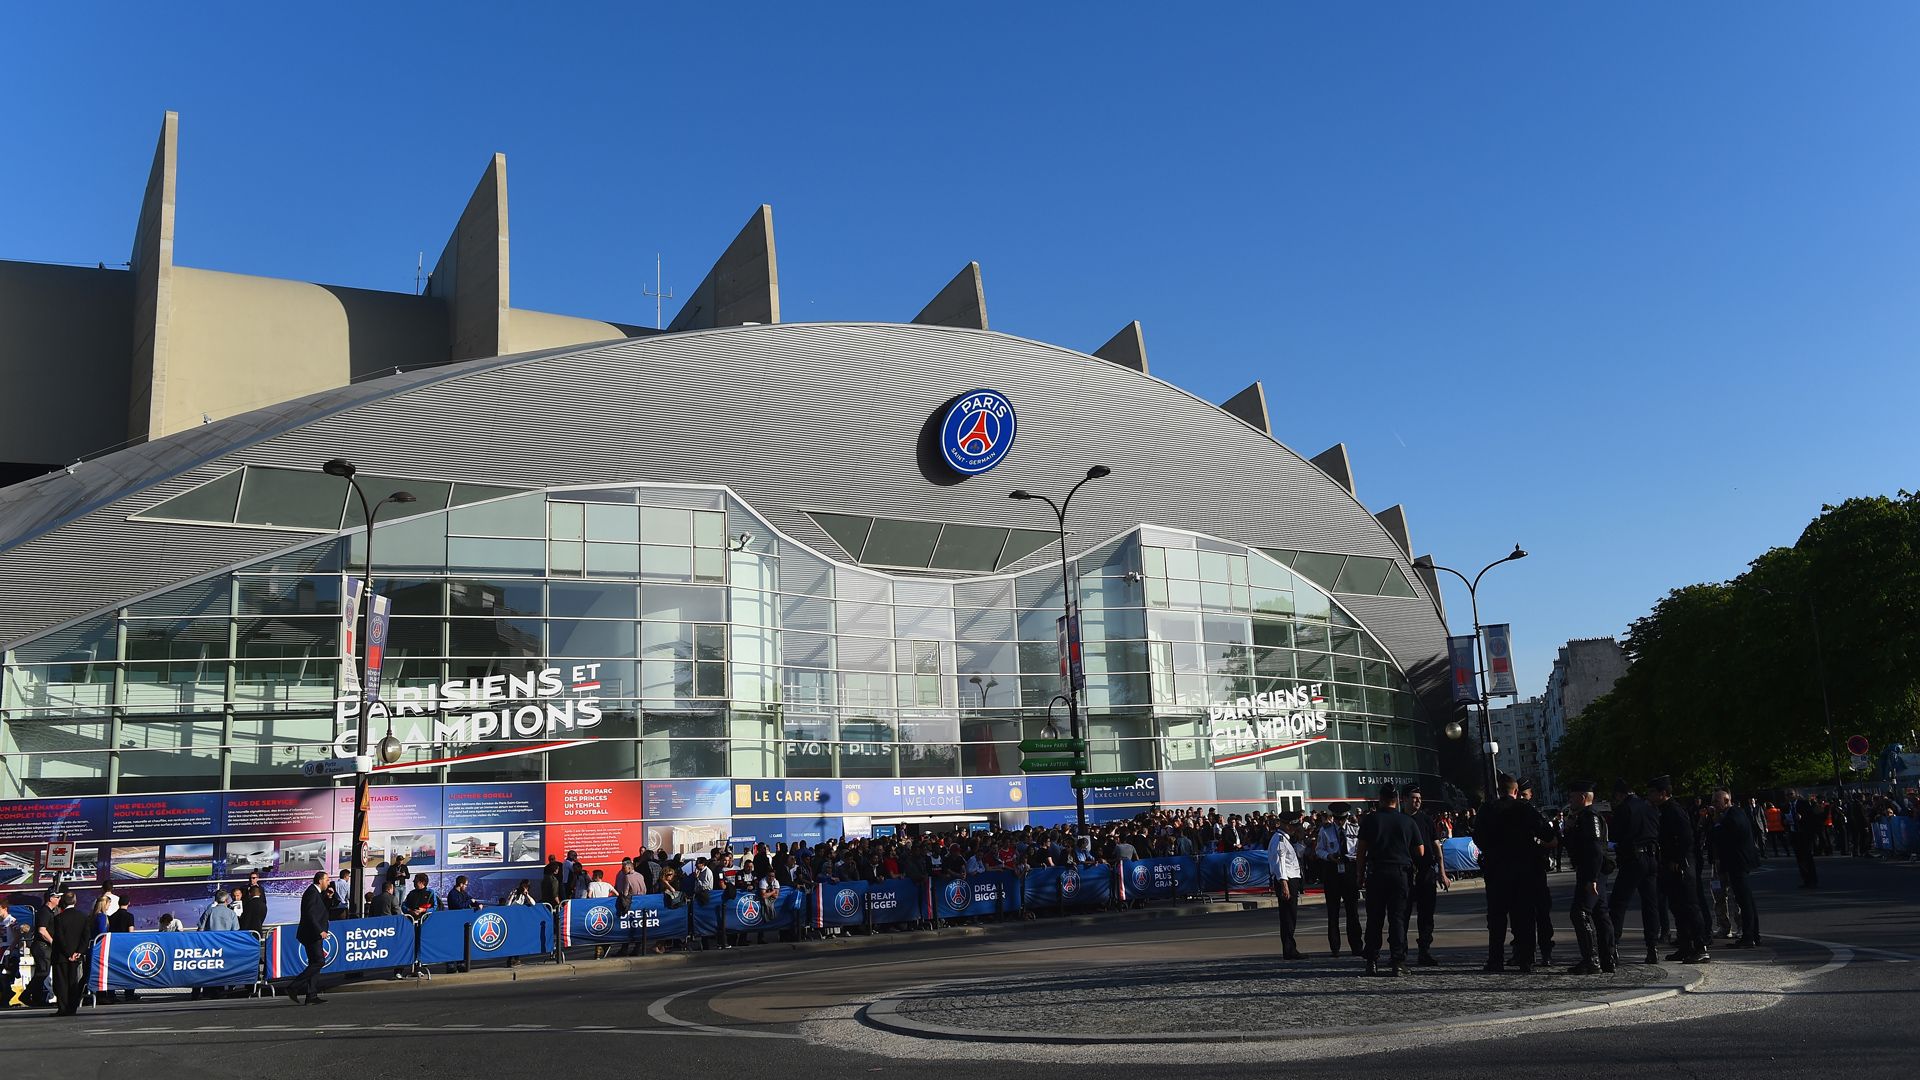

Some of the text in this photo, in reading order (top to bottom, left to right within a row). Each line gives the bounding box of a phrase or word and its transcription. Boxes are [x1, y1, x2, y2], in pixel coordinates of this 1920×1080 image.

[961, 397, 1007, 418] PARIS
[951, 447, 996, 465] SAINT GERMAIN
[336, 667, 563, 724] PARISIENS
[572, 663, 600, 682] ET
[1210, 683, 1323, 724] PARISIENS ET
[1211, 711, 1327, 750] CHAMPIONS
[850, 743, 892, 755] PLUS
[1358, 776, 1366, 785] LE
[1368, 776, 1383, 785] PARC
[755, 788, 820, 801] LE CARRÉ
[893, 784, 973, 796] BIENVENUE
[905, 796, 961, 807] WELCOME
[0, 812, 35, 820] COMPLET
[156, 808, 205, 816] GÉNÉRATION
[1154, 864, 1181, 872] RÊVONS
[975, 892, 1006, 901] BIGGR
[590, 907, 609, 916] PARIS
[478, 915, 501, 924] PARIS
[346, 927, 395, 940] RÊVONS
[135, 944, 160, 953] PARIS
[346, 940, 377, 951] PLUS
[174, 948, 223, 959] DREAM
[345, 949, 388, 961] GRAND
[173, 959, 224, 970] BIGGER
